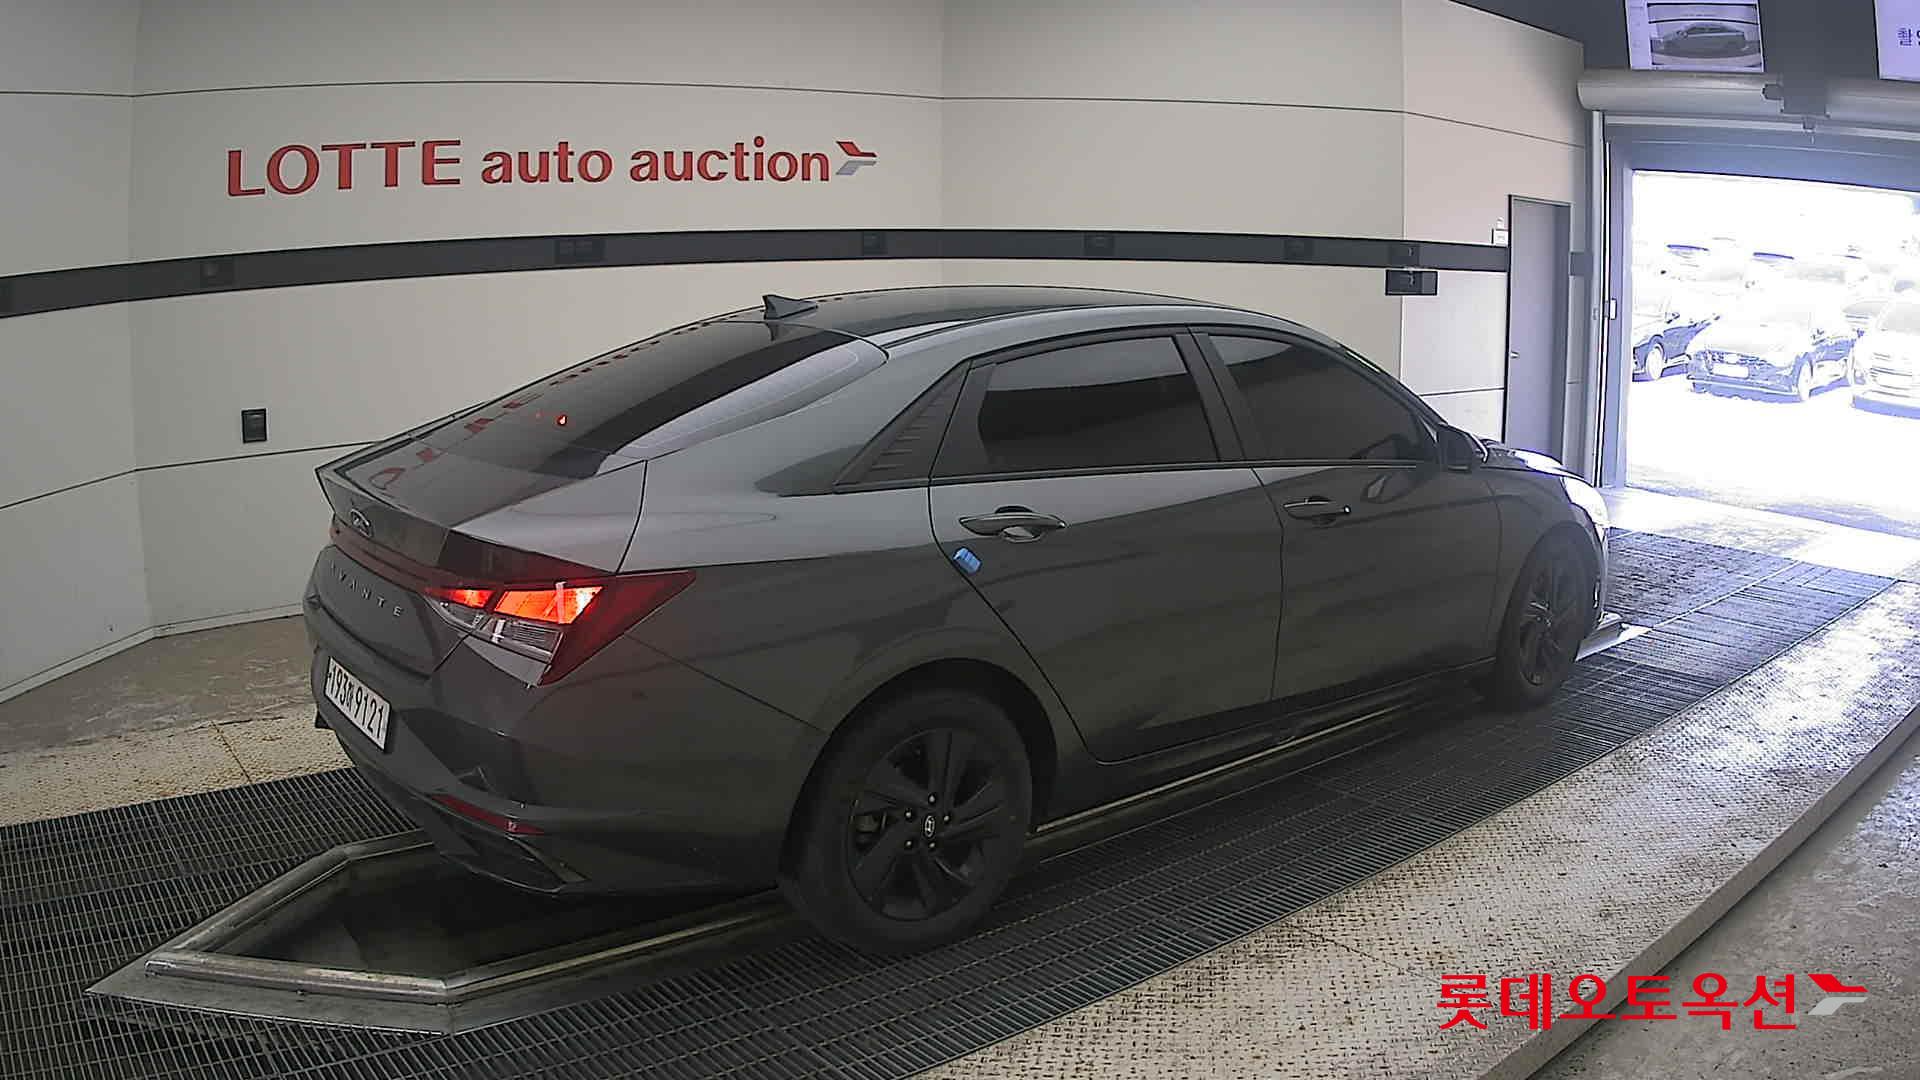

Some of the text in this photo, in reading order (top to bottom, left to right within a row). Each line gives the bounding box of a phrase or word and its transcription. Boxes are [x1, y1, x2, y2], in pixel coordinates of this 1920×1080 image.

[228, 136, 832, 197] LOTTE auto auction
